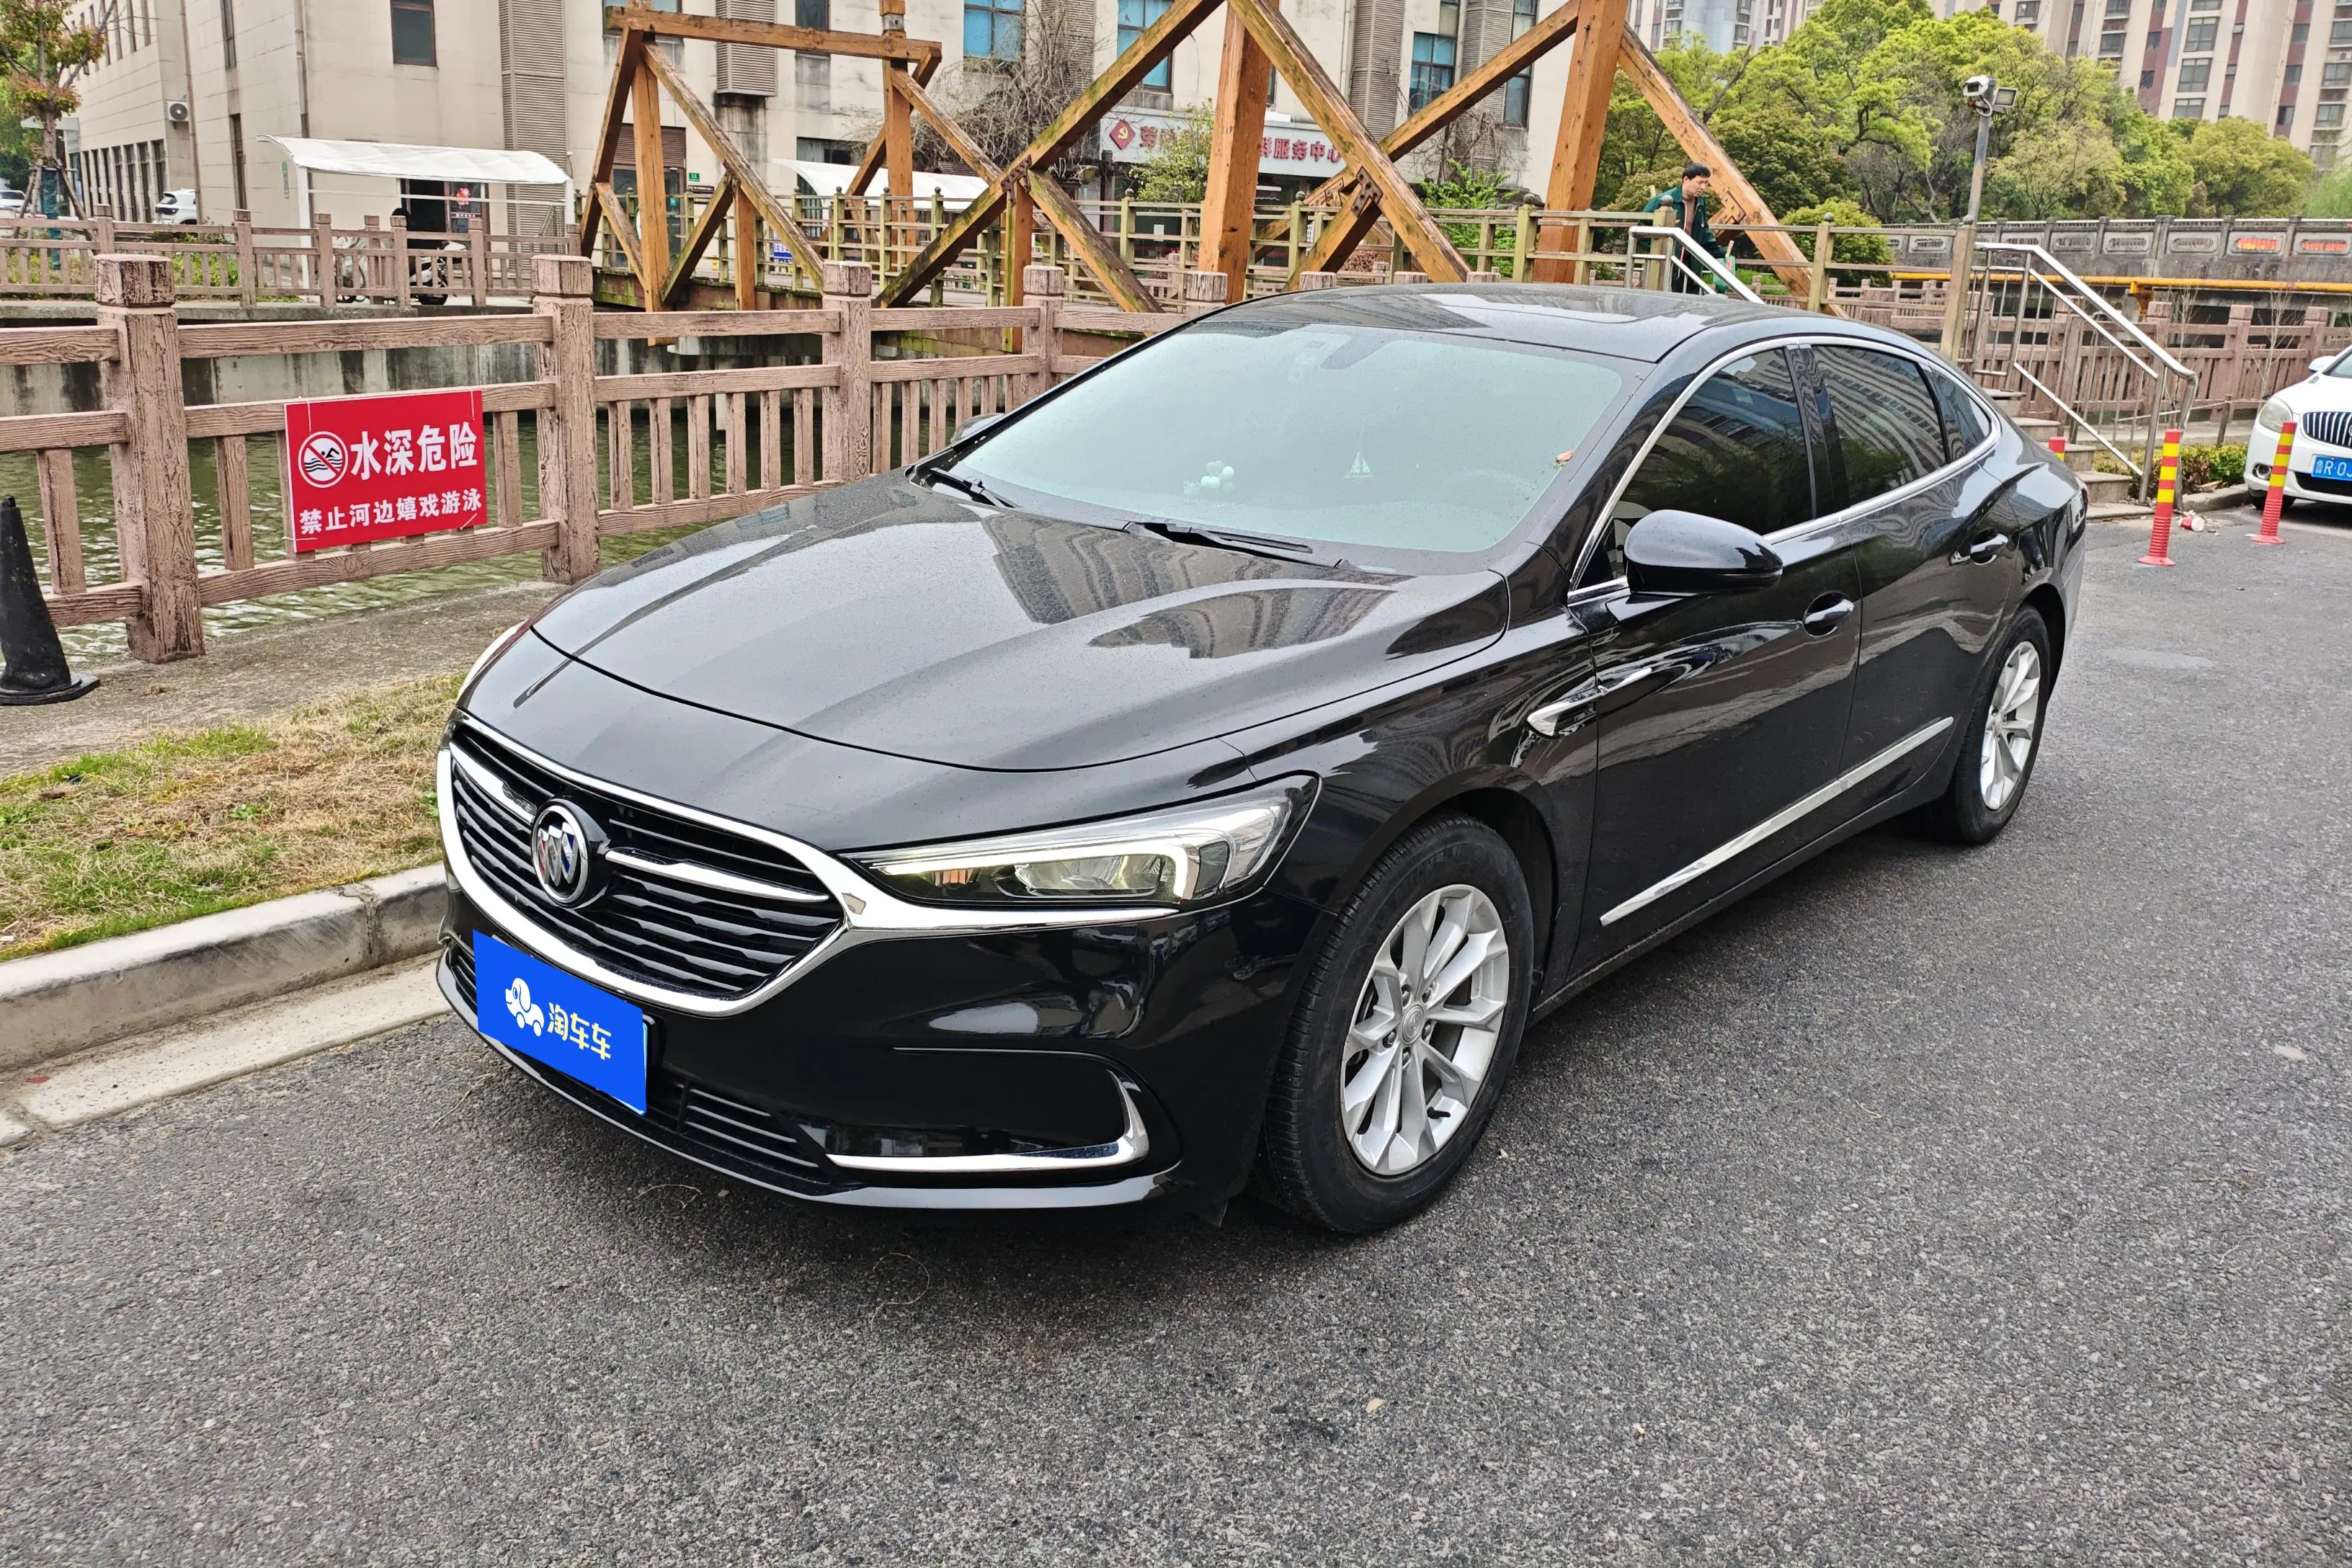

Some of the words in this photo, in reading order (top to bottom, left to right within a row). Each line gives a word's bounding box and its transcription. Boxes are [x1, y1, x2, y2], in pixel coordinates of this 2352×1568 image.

[350, 422, 478, 481] 水深危险
[300, 488, 482, 535] 禁止河边嬉戏游泳
